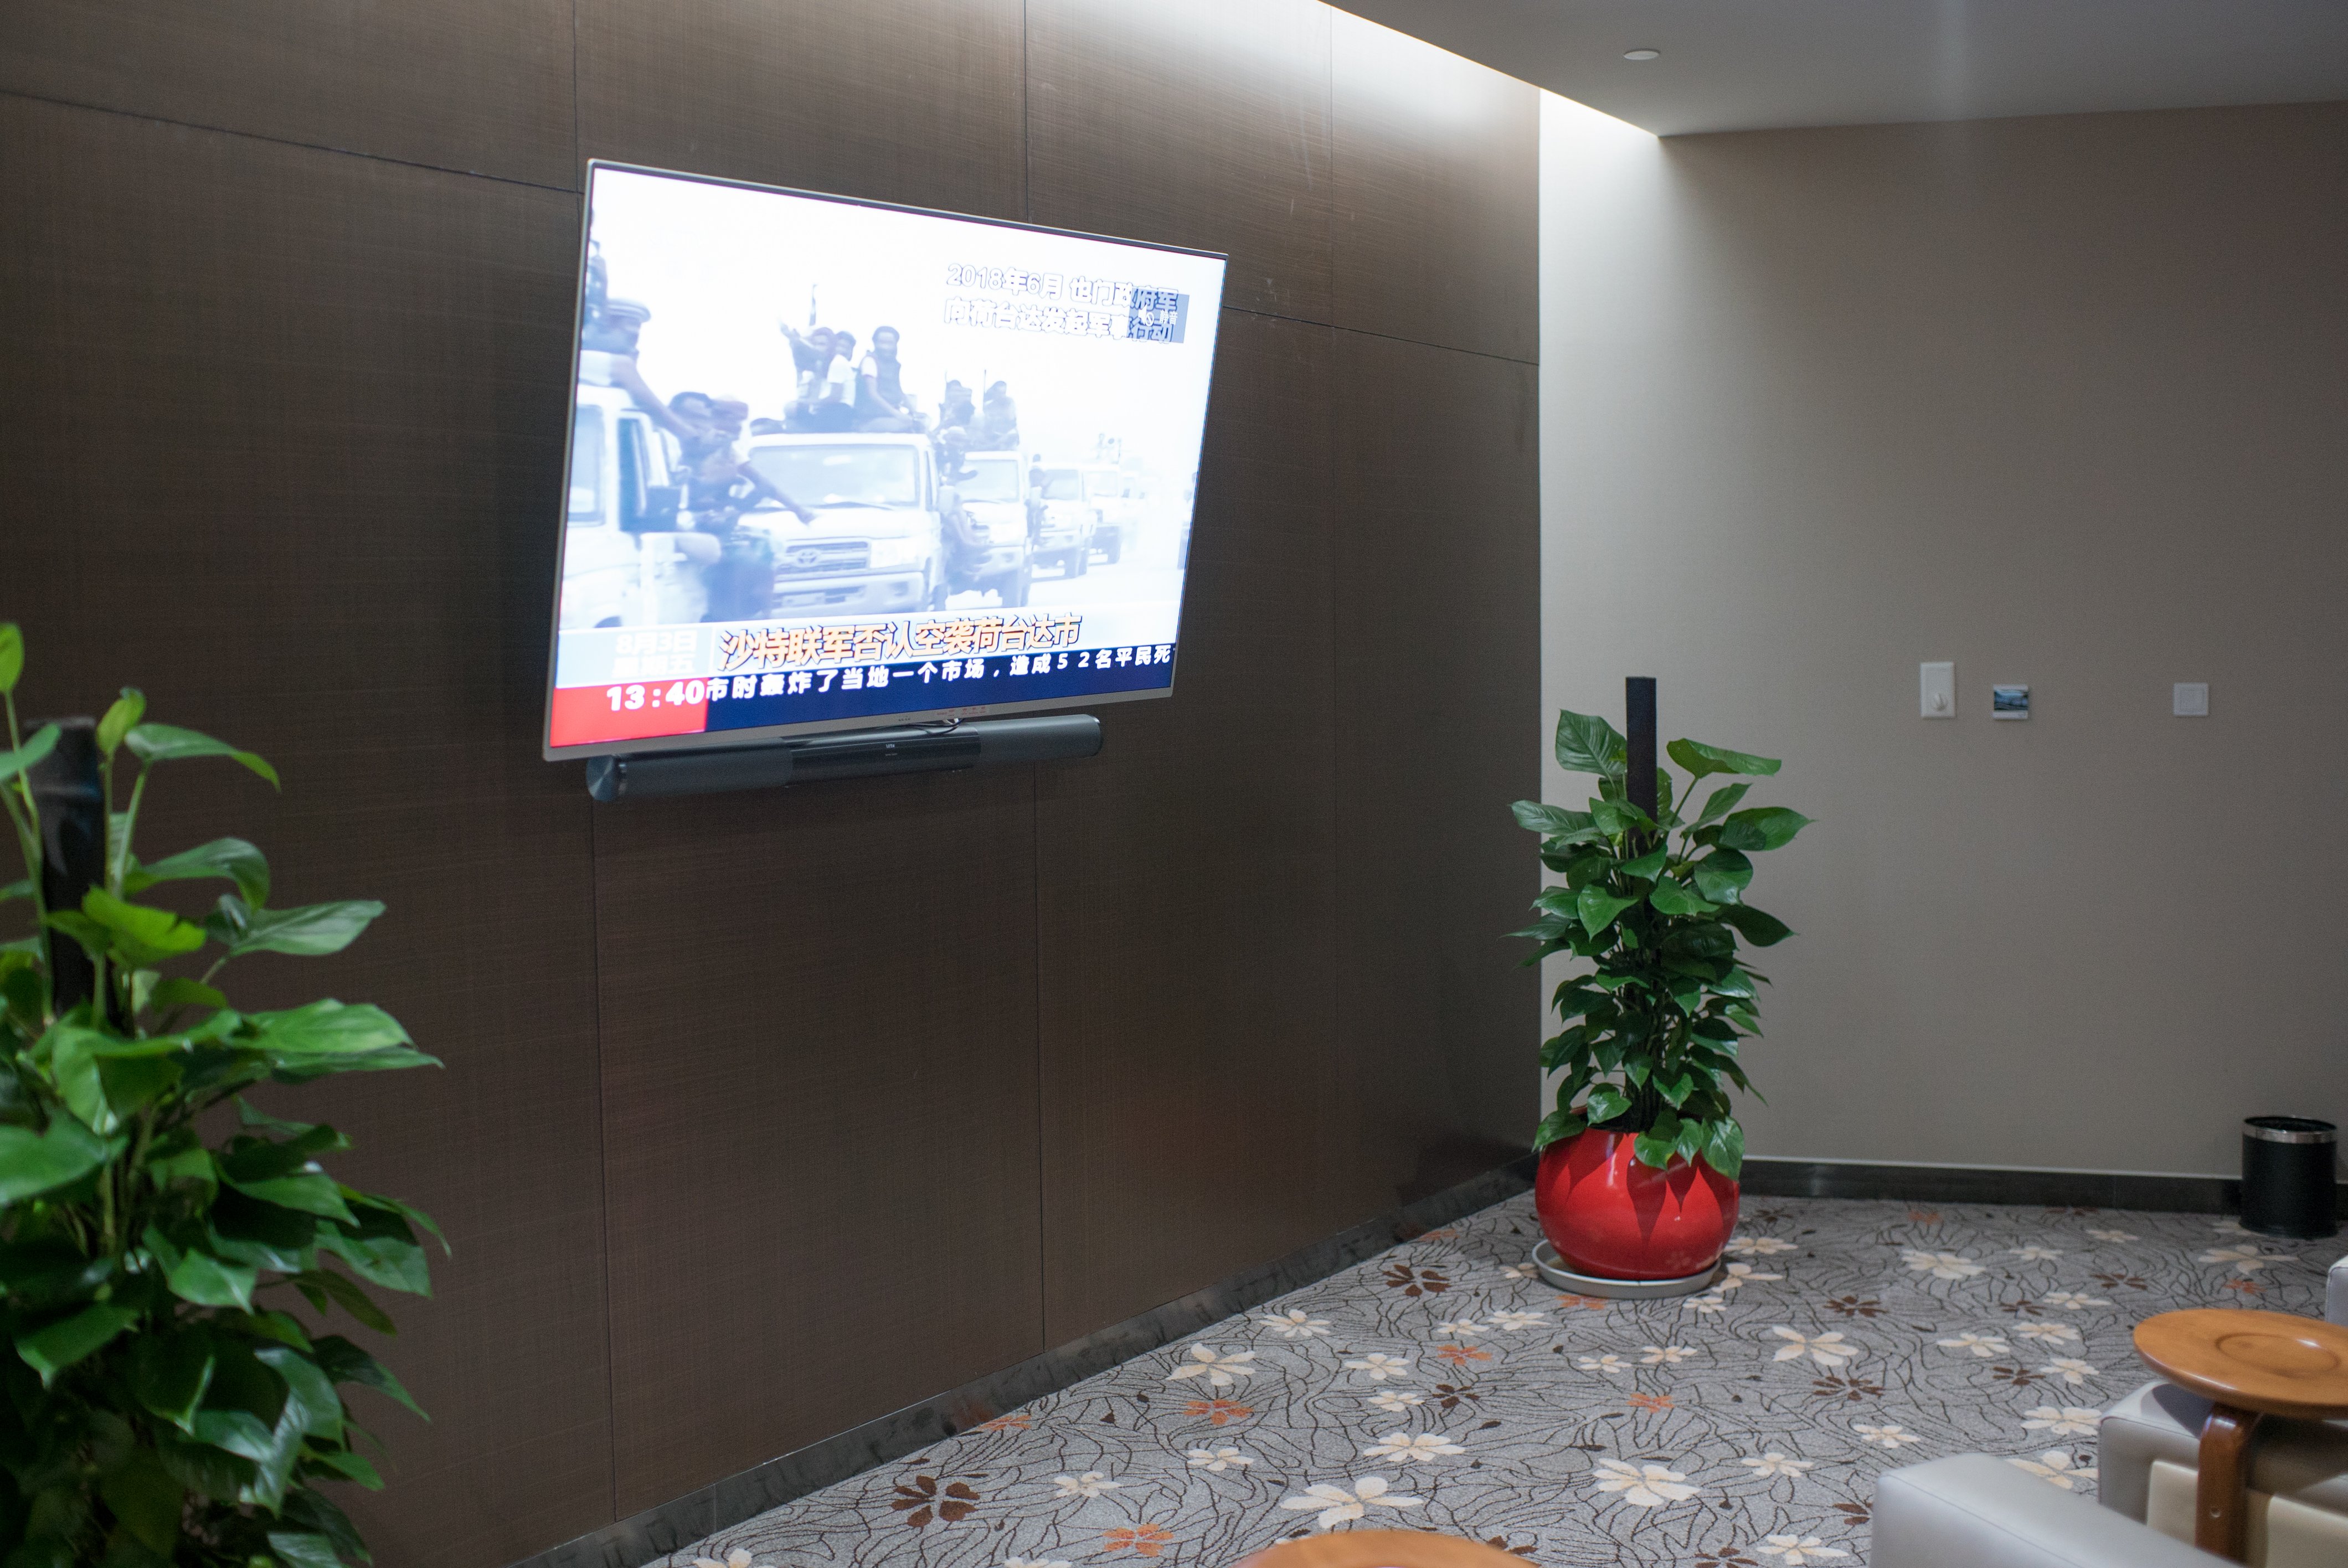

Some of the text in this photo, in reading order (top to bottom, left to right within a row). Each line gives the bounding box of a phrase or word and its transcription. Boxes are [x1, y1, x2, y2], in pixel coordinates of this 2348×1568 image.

[946, 263, 1064, 301] 2018年6月
[1159, 309, 1178, 326] 静音
[718, 612, 1082, 671] 沙特联军否认空袭荷台达市
[606, 679, 705, 711] 13:40
